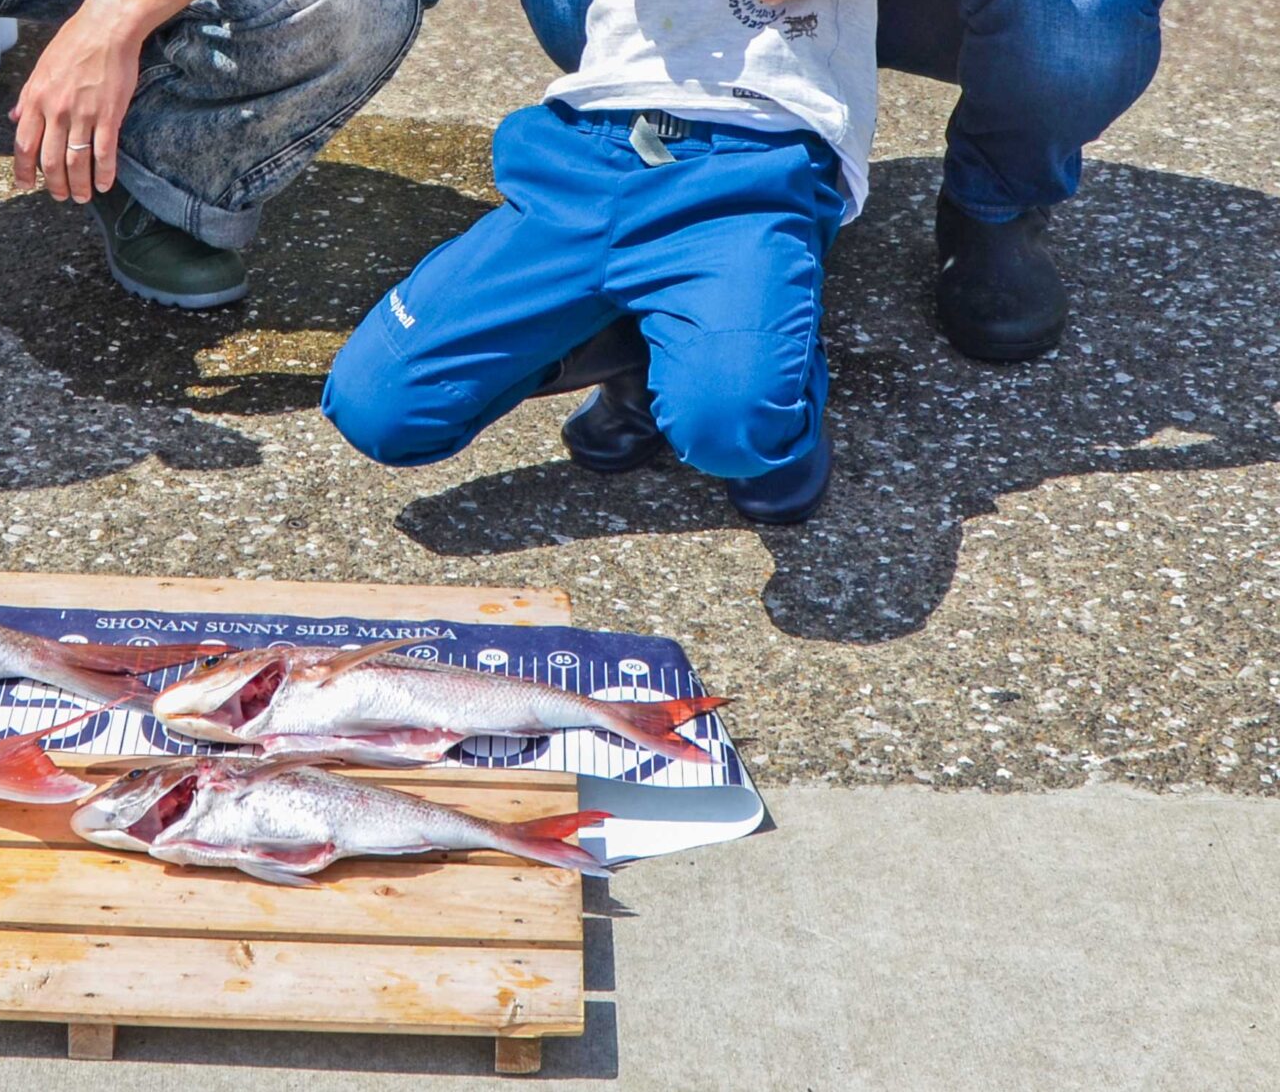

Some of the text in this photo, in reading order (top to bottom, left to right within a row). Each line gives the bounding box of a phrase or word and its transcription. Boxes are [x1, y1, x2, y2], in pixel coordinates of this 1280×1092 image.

[95, 616, 458, 640] SHONAN SUNNY SIDE MARINA
[414, 648, 642, 671] 75 80 85 90
